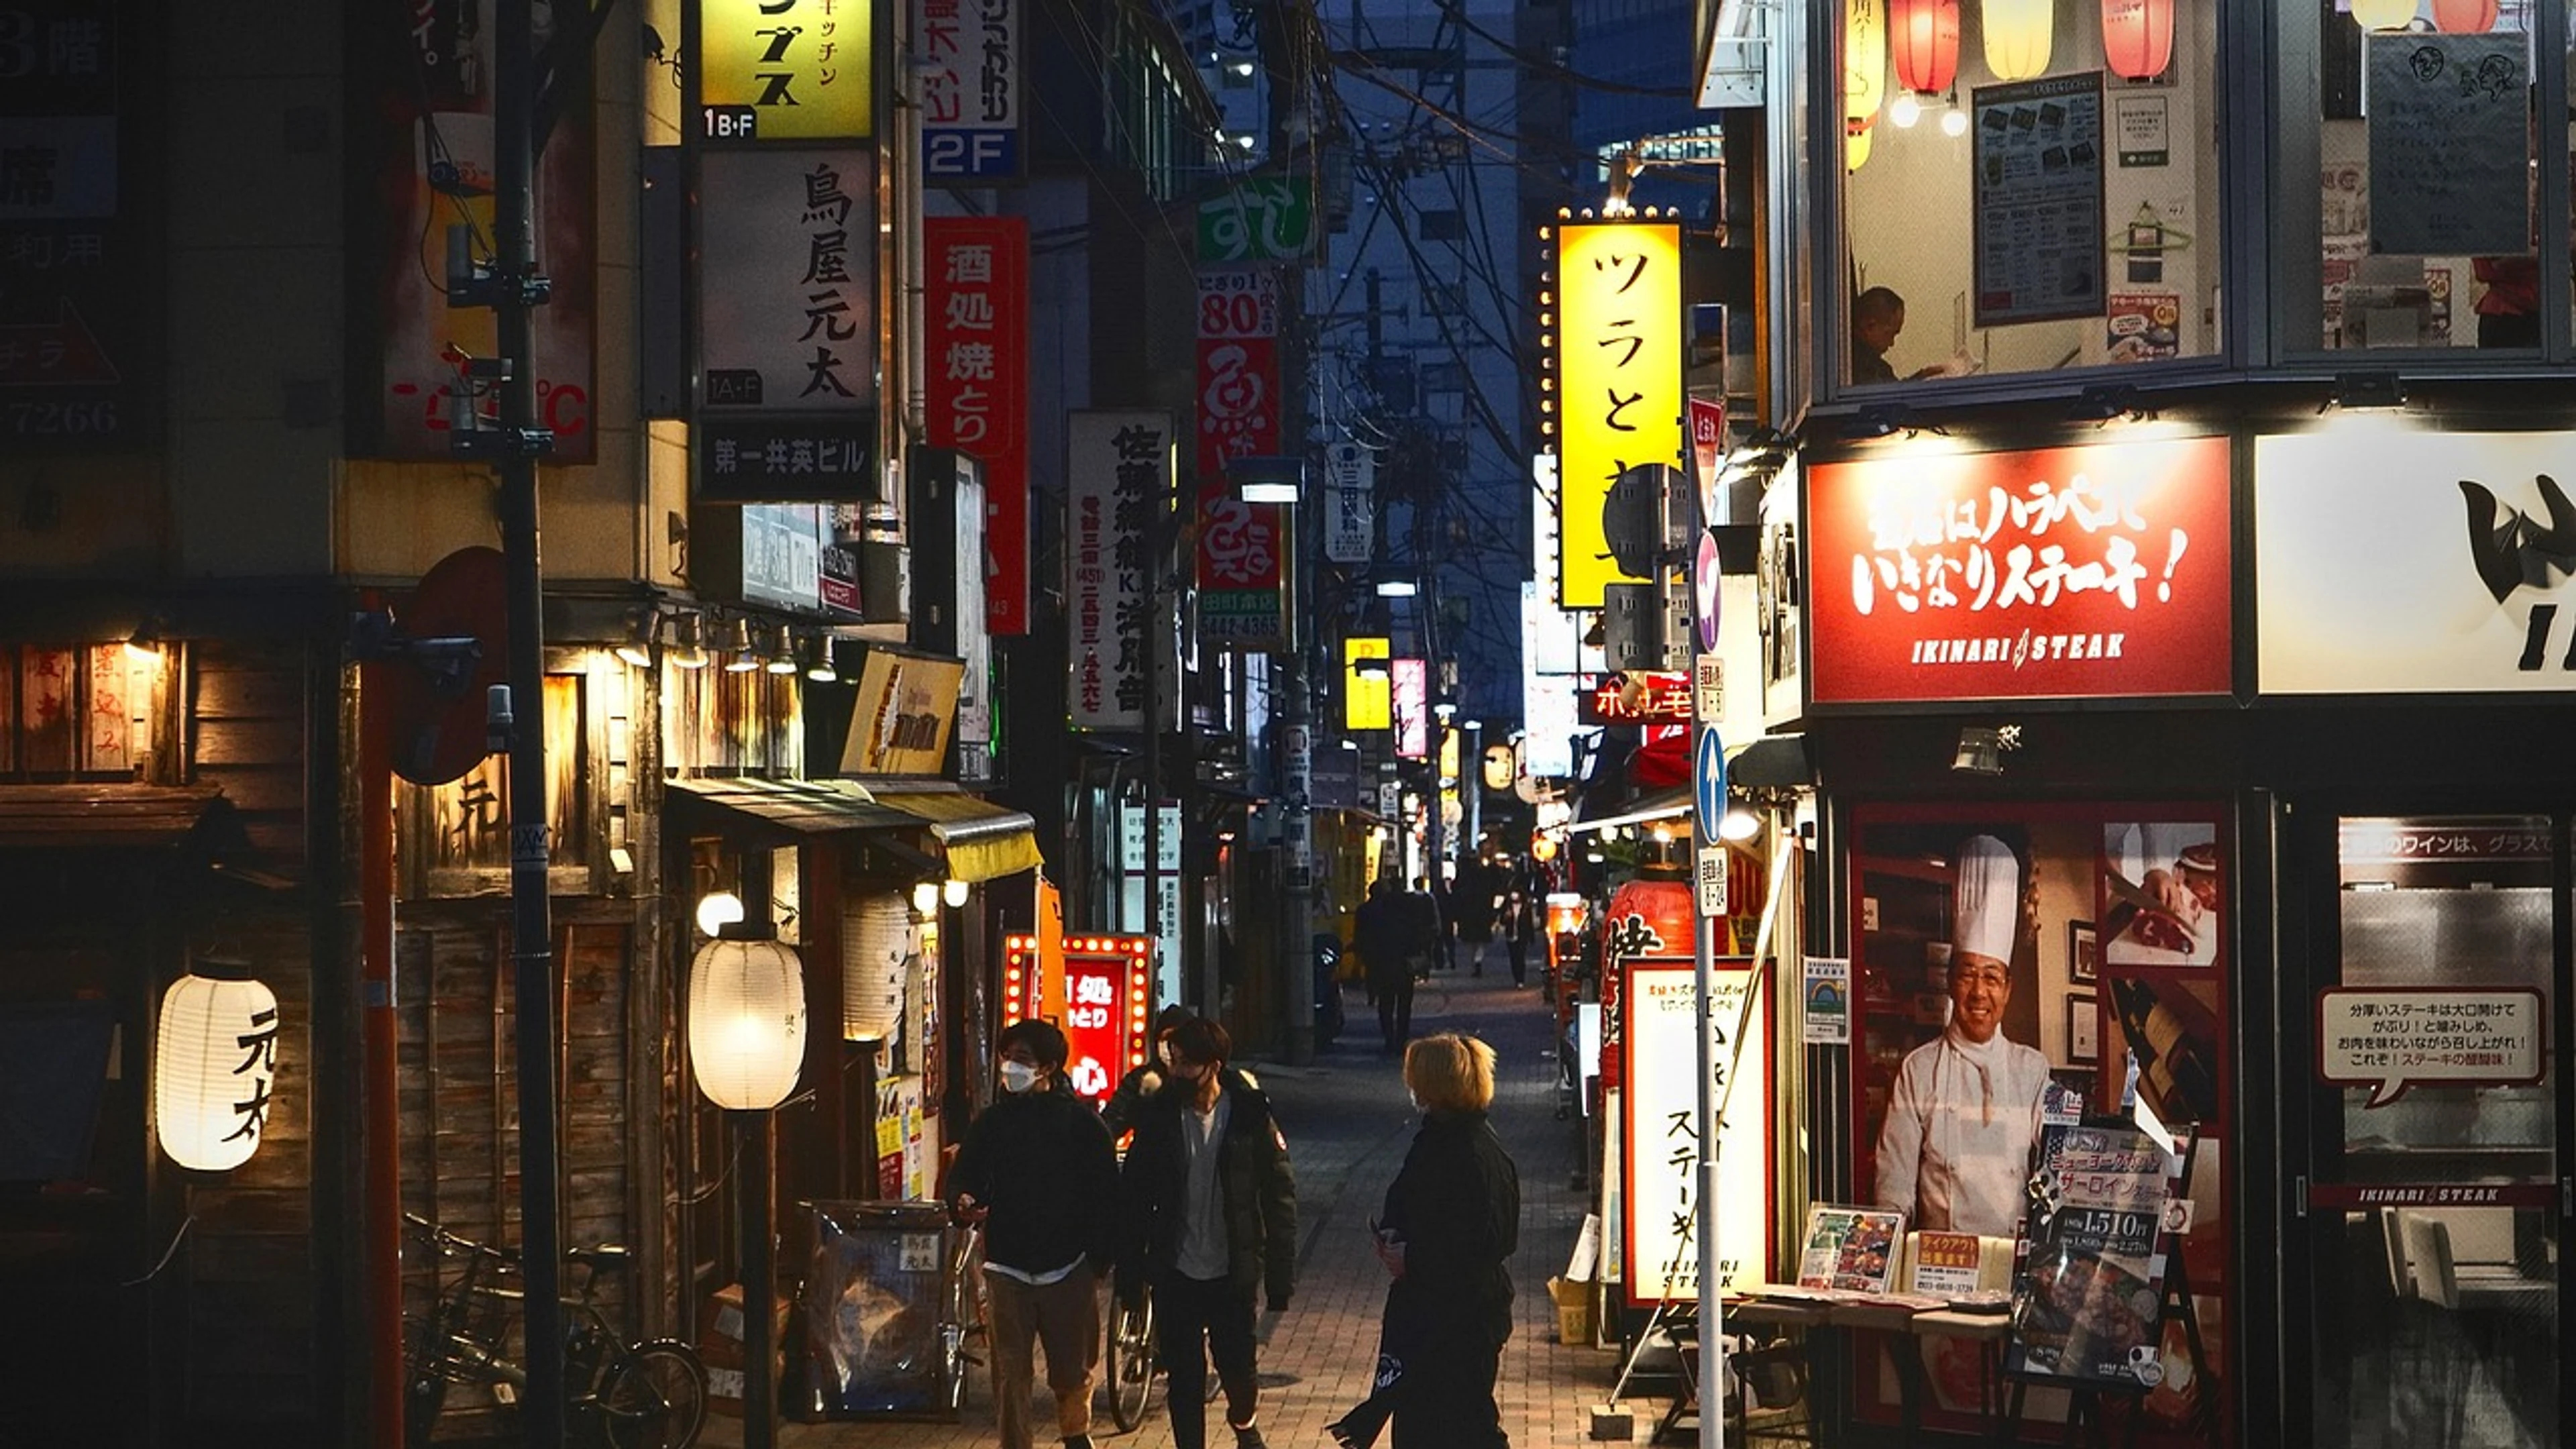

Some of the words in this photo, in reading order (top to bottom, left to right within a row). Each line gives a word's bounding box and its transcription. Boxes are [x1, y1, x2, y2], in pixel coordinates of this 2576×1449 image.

[930, 133, 1005, 172] 2F
[799, 164, 857, 398] 鳥屋元太
[945, 246, 994, 331] 酒処
[1201, 294, 1258, 334] 80
[945, 341, 994, 443] 焼とり
[714, 438, 865, 474] 第一共英ビル
[1911, 636, 2011, 663] IKINARI
[2031, 633, 2124, 659] STEAK
[1067, 1008, 1108, 1028] とり
[221, 1008, 278, 1142] 元太
[2359, 1189, 2424, 1201] IKINARI
[2438, 1189, 2498, 1201] STEAK
[1662, 1260, 1739, 1273] IKINRI
[1663, 1275, 1733, 1287] STEK
